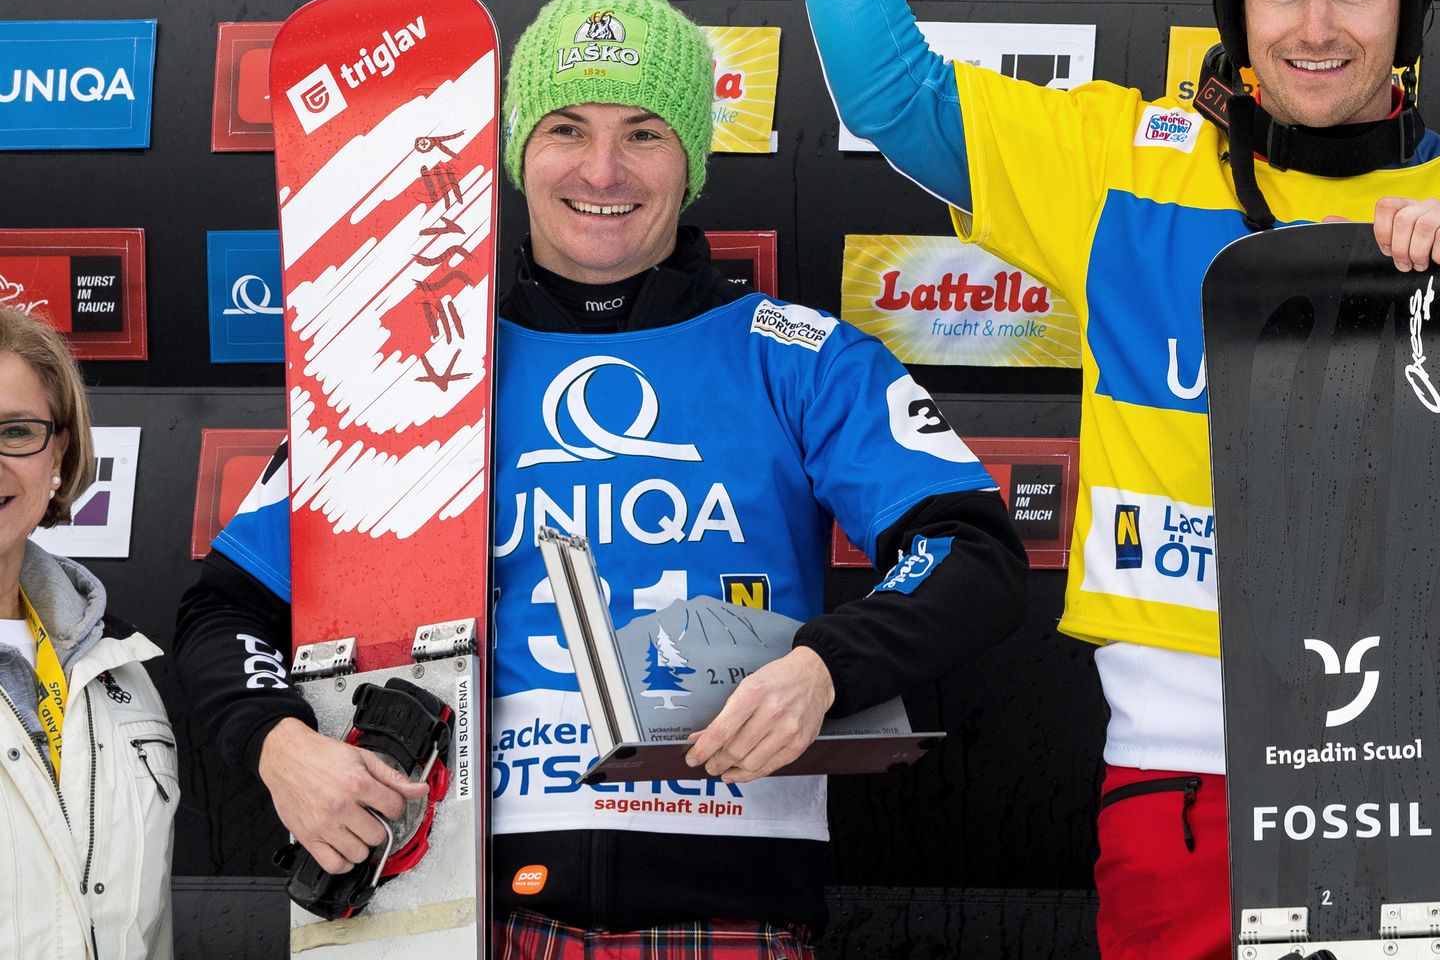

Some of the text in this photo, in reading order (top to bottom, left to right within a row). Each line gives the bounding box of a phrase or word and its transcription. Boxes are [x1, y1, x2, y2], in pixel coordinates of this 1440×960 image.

[339, 15, 428, 89] triglav
[557, 42, 640, 73] LAŠKO
[583, 68, 607, 77] 1825
[0, 67, 135, 102] UNIQA
[1150, 117, 1189, 133] Snow
[1151, 130, 1171, 141] Day
[77, 276, 115, 287] WURST
[77, 289, 92, 300] IM
[873, 270, 1051, 314] Lattella
[78, 302, 115, 313] RAUCH
[585, 297, 624, 312] mico
[755, 314, 823, 343] WORLD CUP
[758, 308, 828, 338] SNOWBOARD
[931, 317, 1047, 339] frucht & molke
[1016, 484, 1056, 495] WURST
[1015, 497, 1031, 508] IM
[1014, 509, 1053, 521] RAUCH
[707, 668, 725, 685] 2.
[460, 679, 469, 797] MADE IN SLOVENIA
[1265, 738, 1423, 769] Engadin Scuol
[594, 797, 743, 818] sagenhaft alpin
[1252, 801, 1433, 841] FOSSIL
[1321, 888, 1333, 906] 2
